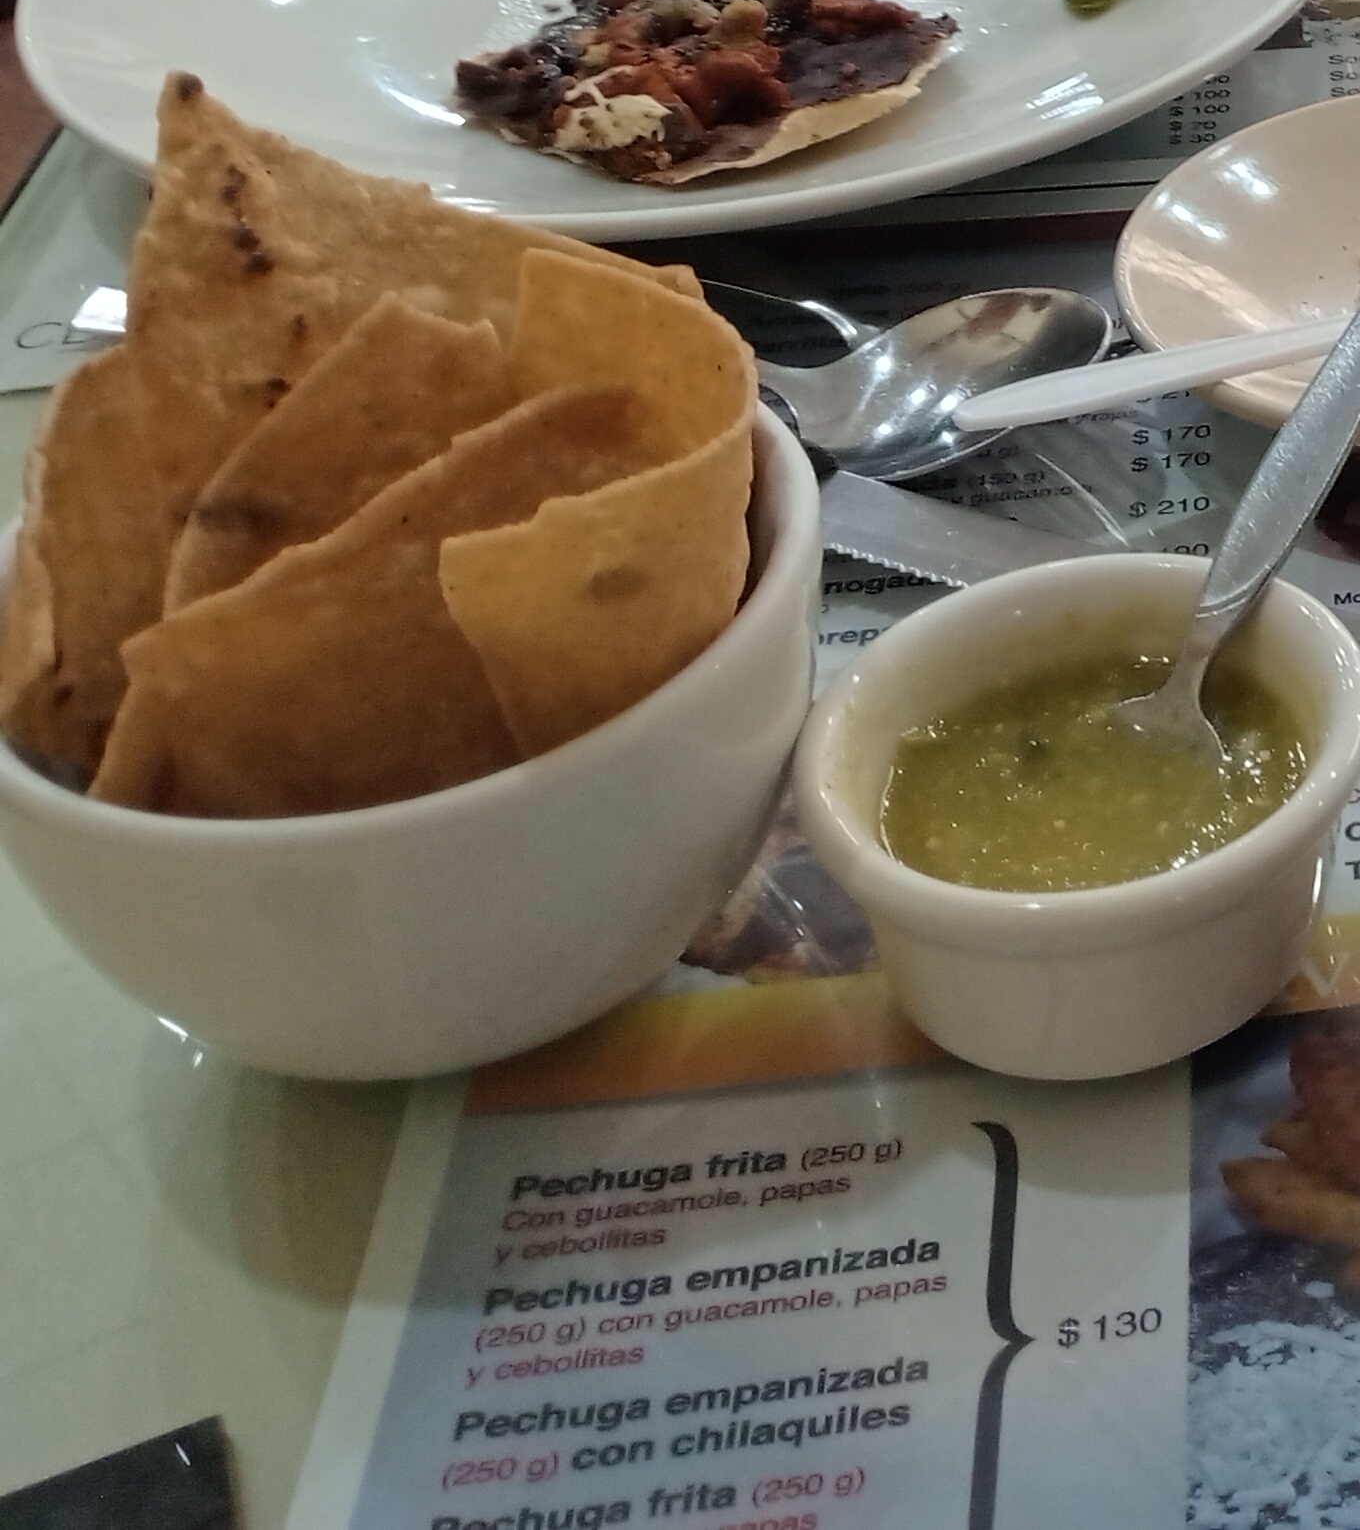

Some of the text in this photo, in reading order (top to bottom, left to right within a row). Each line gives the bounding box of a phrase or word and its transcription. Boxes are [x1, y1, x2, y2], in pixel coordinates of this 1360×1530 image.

[1131, 423, 1212, 446] $ 170
[1129, 450, 1211, 473] $ 170
[1127, 496, 1211, 519] $ 210
[509, 1137, 905, 1202] Pechuga frita (250 g)
[501, 1174, 852, 1232] Con guacamole, papas
[494, 1226, 668, 1269] y cebollitas
[481, 1236, 941, 1318] Pechuga empanizada
[473, 1272, 949, 1355] (250 g) con guacamole, papas
[1056, 1306, 1164, 1350] $ 130
[464, 1344, 645, 1390] y cebollitas
[452, 1355, 931, 1444] Pechuga empanizada
[440, 1400, 914, 1493] (250 g) con chilaquiles
[647, 1484, 738, 1518] frita
[751, 1474, 823, 1508] (250
[833, 1466, 867, 1496] g)
[719, 1512, 818, 1530] pas
